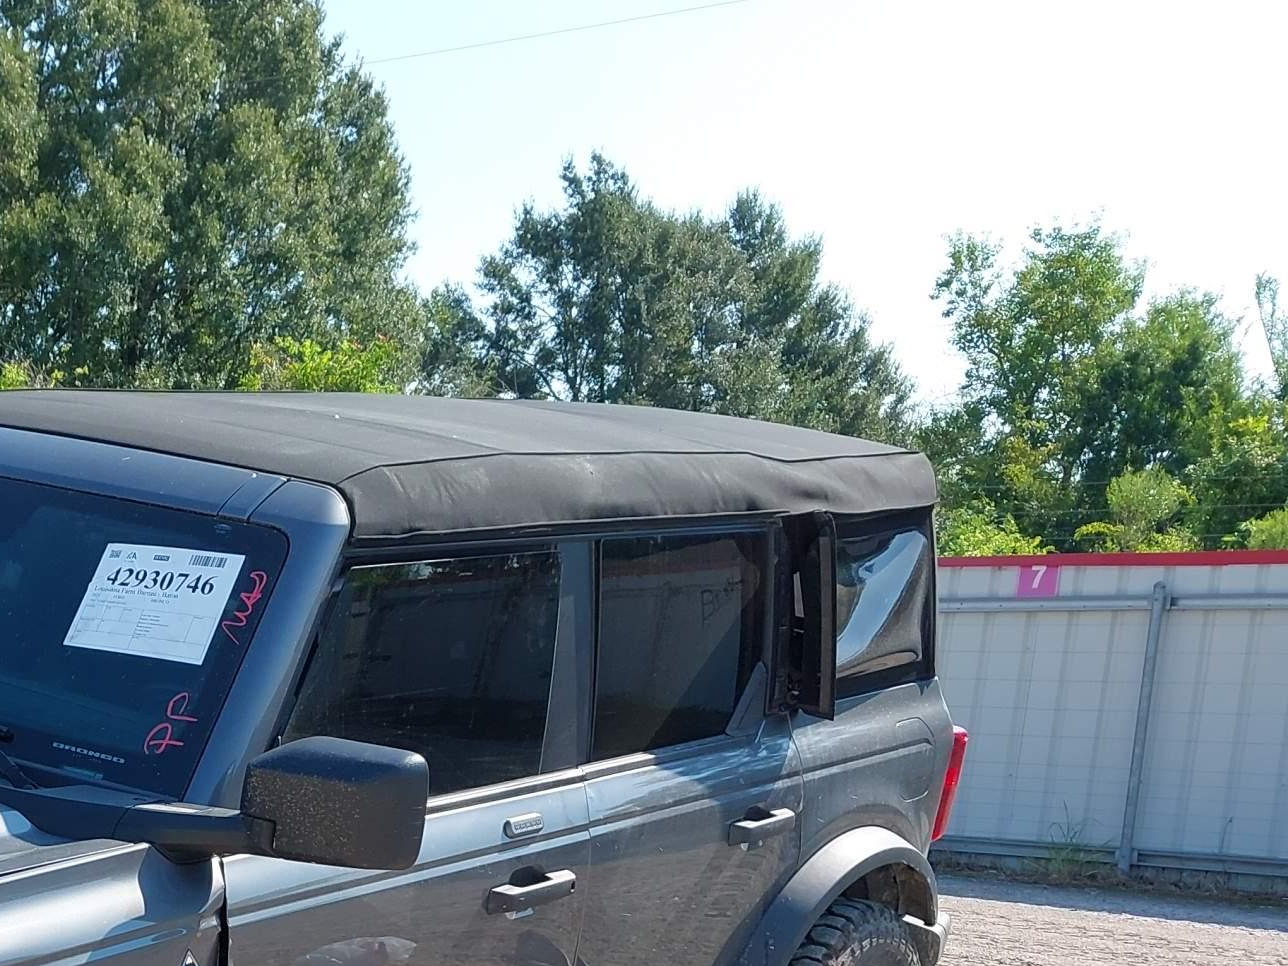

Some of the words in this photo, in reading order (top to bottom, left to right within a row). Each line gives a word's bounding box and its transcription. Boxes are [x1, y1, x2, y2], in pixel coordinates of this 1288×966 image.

[106, 566, 219, 596] 42930746
[1031, 565, 1047, 589] 7
[52, 741, 126, 765] BRONCO
